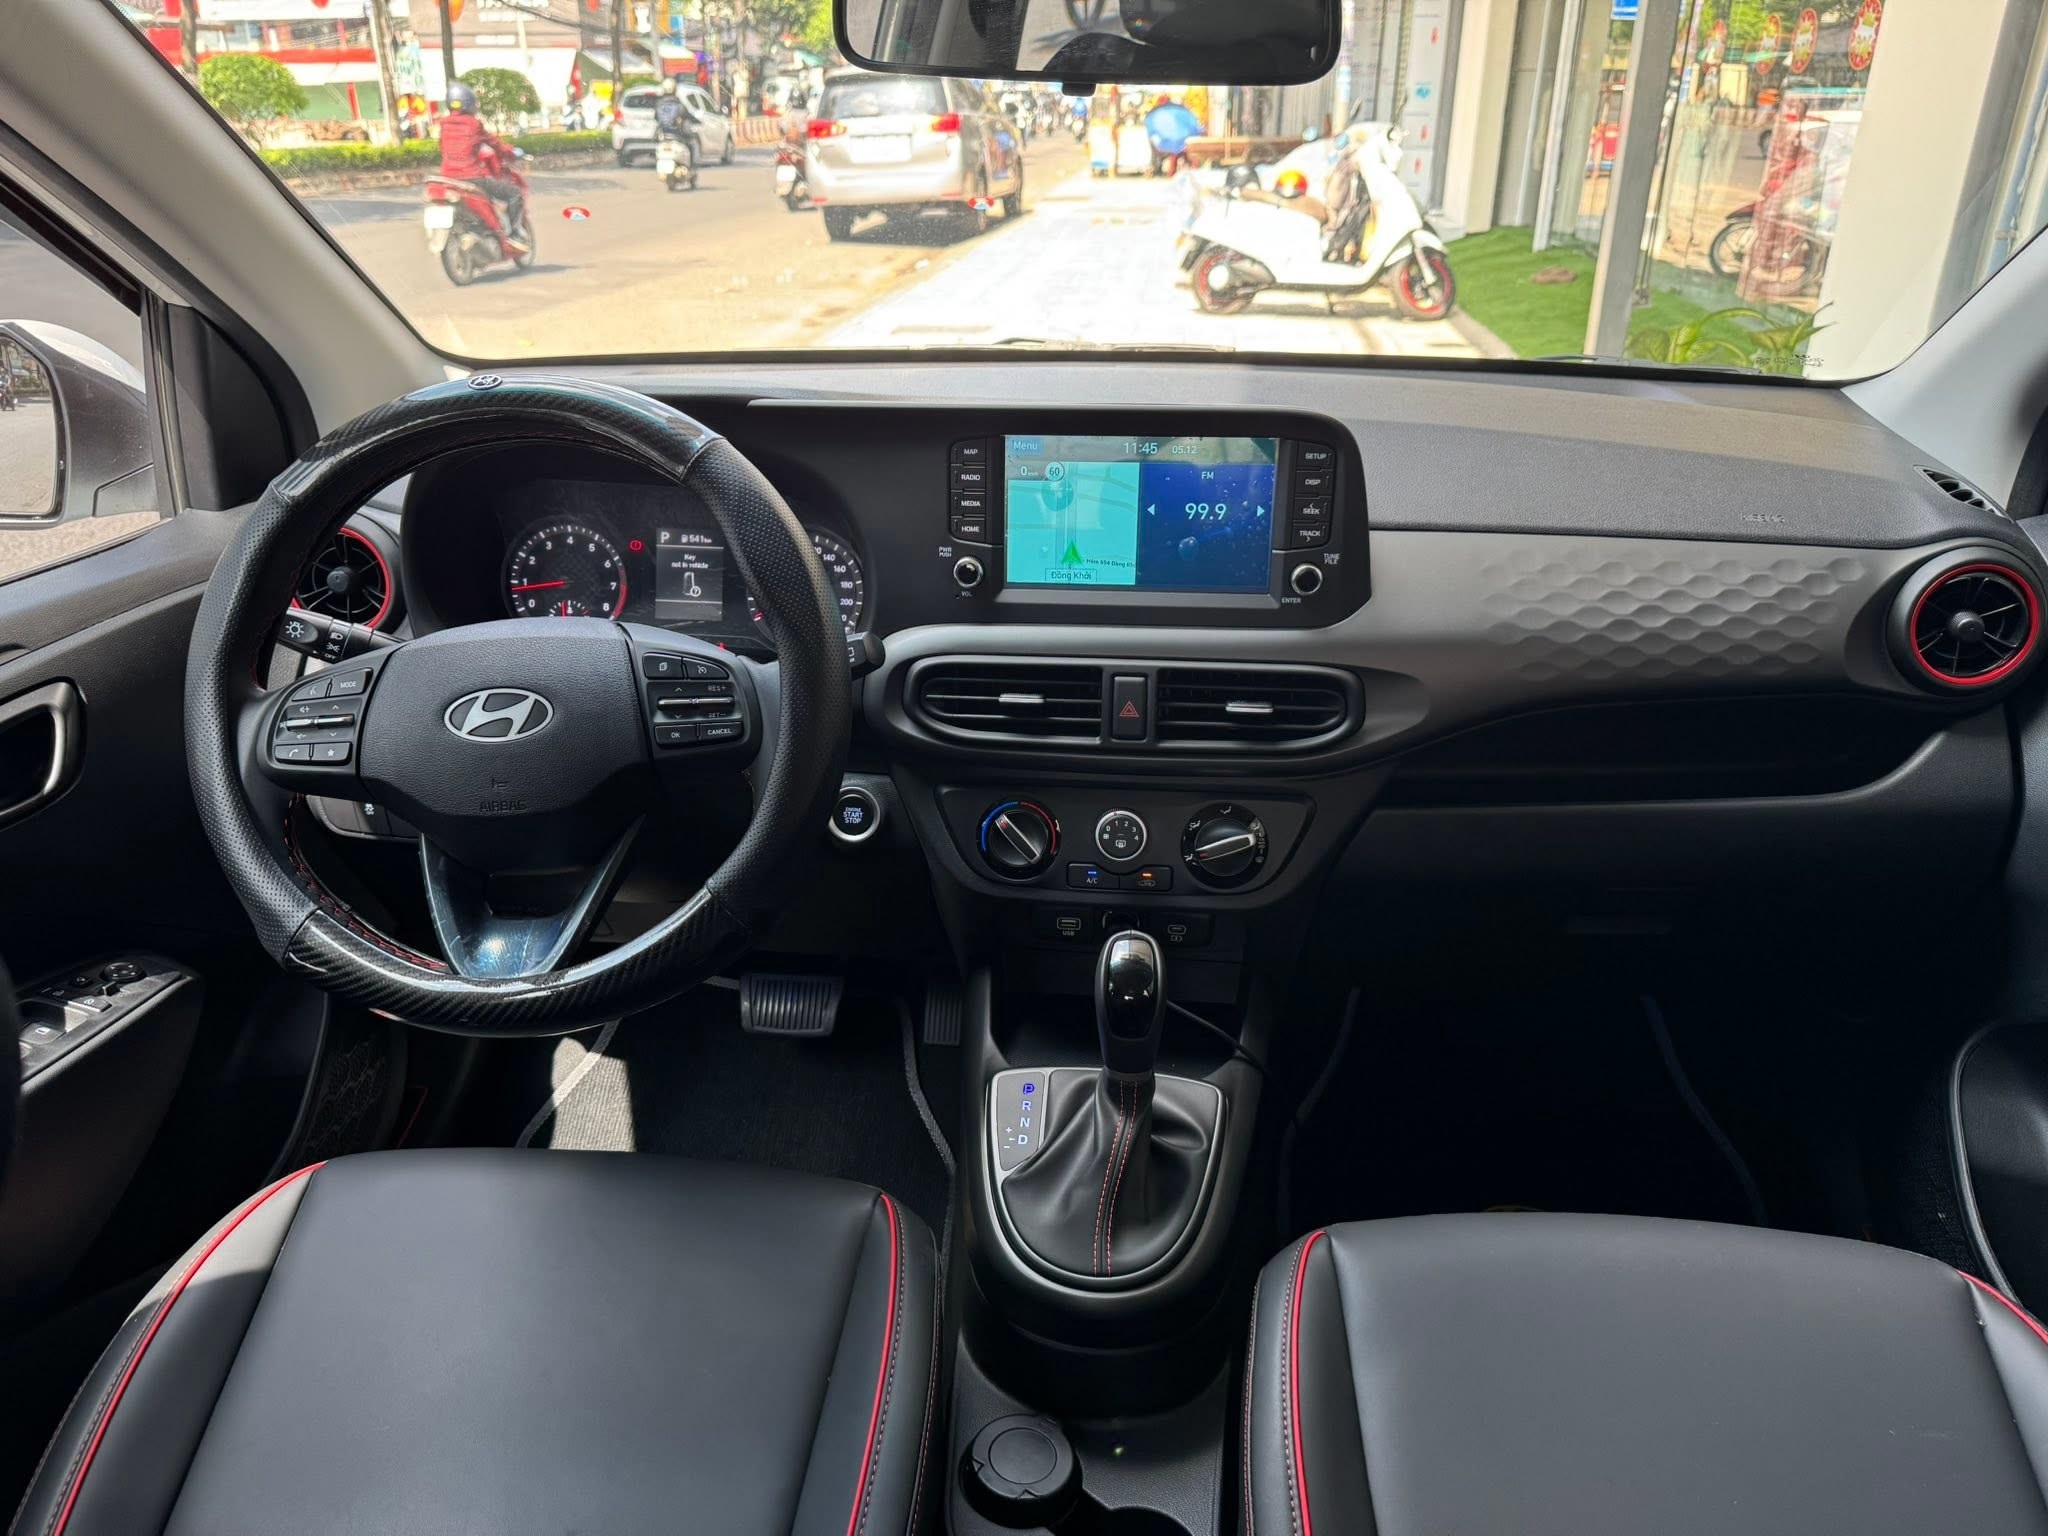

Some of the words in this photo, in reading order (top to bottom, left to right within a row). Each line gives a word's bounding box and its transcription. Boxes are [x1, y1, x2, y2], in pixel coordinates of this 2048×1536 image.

[1013, 440, 1038, 450] Menu
[1124, 442, 1158, 454] 11:45
[1172, 445, 1197, 454] 05.12
[1020, 466, 1027, 476] 0
[1049, 466, 1060, 476] 60
[1201, 471, 1214, 480] FM
[1185, 502, 1227, 520] 99.9
[567, 536, 573, 544] 4
[661, 531, 670, 543] P
[546, 541, 552, 550] 3
[588, 543, 595, 552] 5
[529, 556, 536, 565] 2
[823, 553, 836, 561] 140
[604, 560, 611, 568] 6
[833, 565, 846, 573] 160
[610, 582, 617, 590] 7
[528, 599, 535, 608] 0
[840, 598, 853, 606] 200
[602, 603, 609, 611] 8
[1023, 1083, 1035, 1094] P
[1022, 1100, 1031, 1111] R
[1020, 1117, 1030, 1127] N
[1018, 1134, 1028, 1145] D
